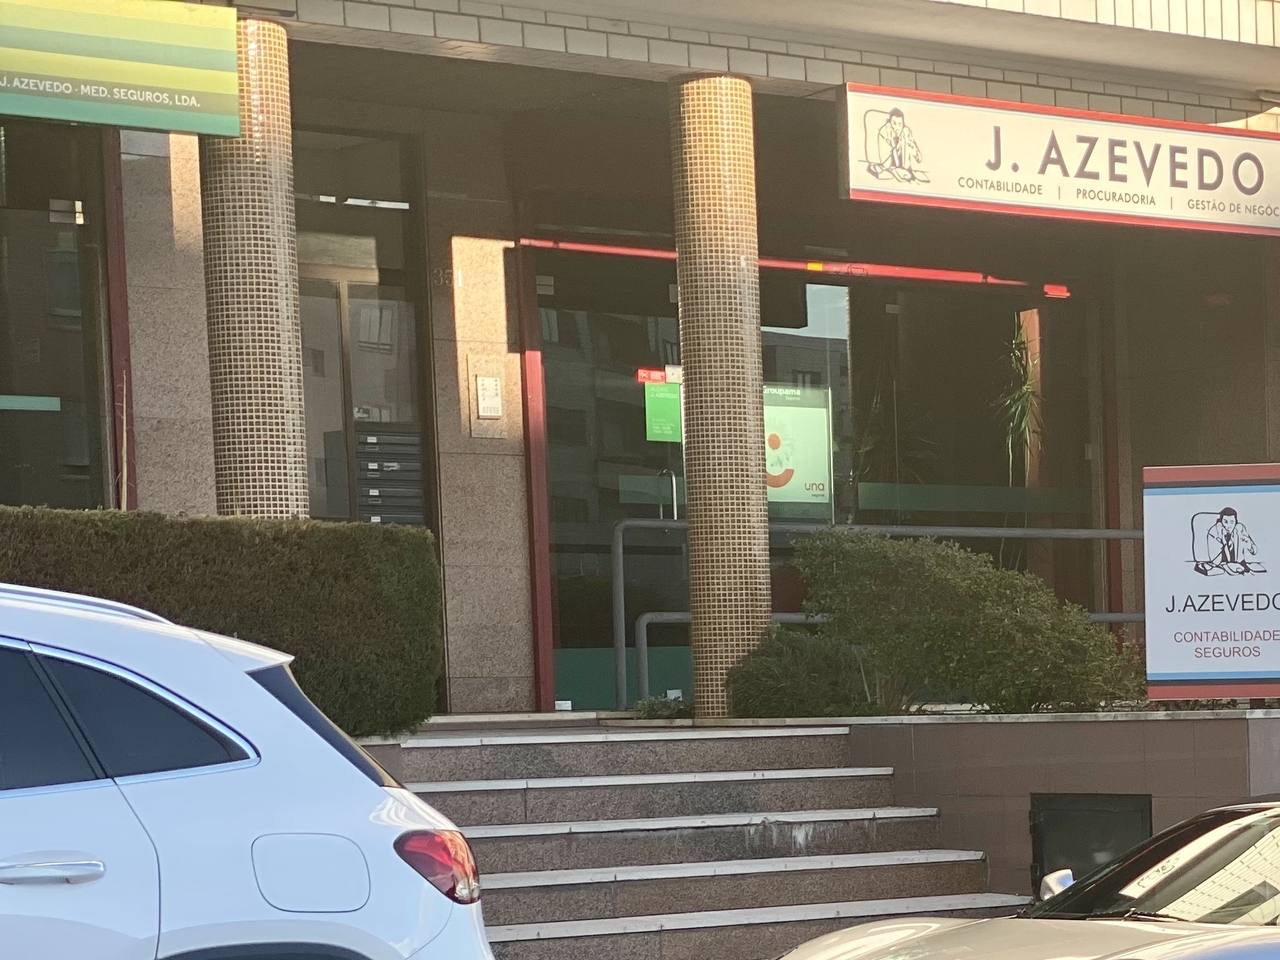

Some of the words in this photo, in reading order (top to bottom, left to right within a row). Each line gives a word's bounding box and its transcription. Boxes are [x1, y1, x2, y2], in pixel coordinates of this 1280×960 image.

[0, 76, 10, 87] J.
[13, 78, 72, 94] AZEVEDO
[80, 85, 110, 98] MED.
[113, 88, 173, 105] SEGUROS,
[175, 95, 201, 107] LDA.
[985, 125, 1020, 173] J.
[1037, 129, 1265, 196] AZEVEDO
[957, 176, 1043, 196] CONTABILIDADE
[1076, 188, 1157, 206] PROCURADORIA
[1187, 197, 1226, 212] GESTÃO
[1229, 203, 1242, 214] DE
[433, 267, 463, 288] 351
[804, 482, 825, 491] una
[1173, 629, 1280, 643] CONTABILIDADE
[1194, 646, 1261, 659] SEGUROS
